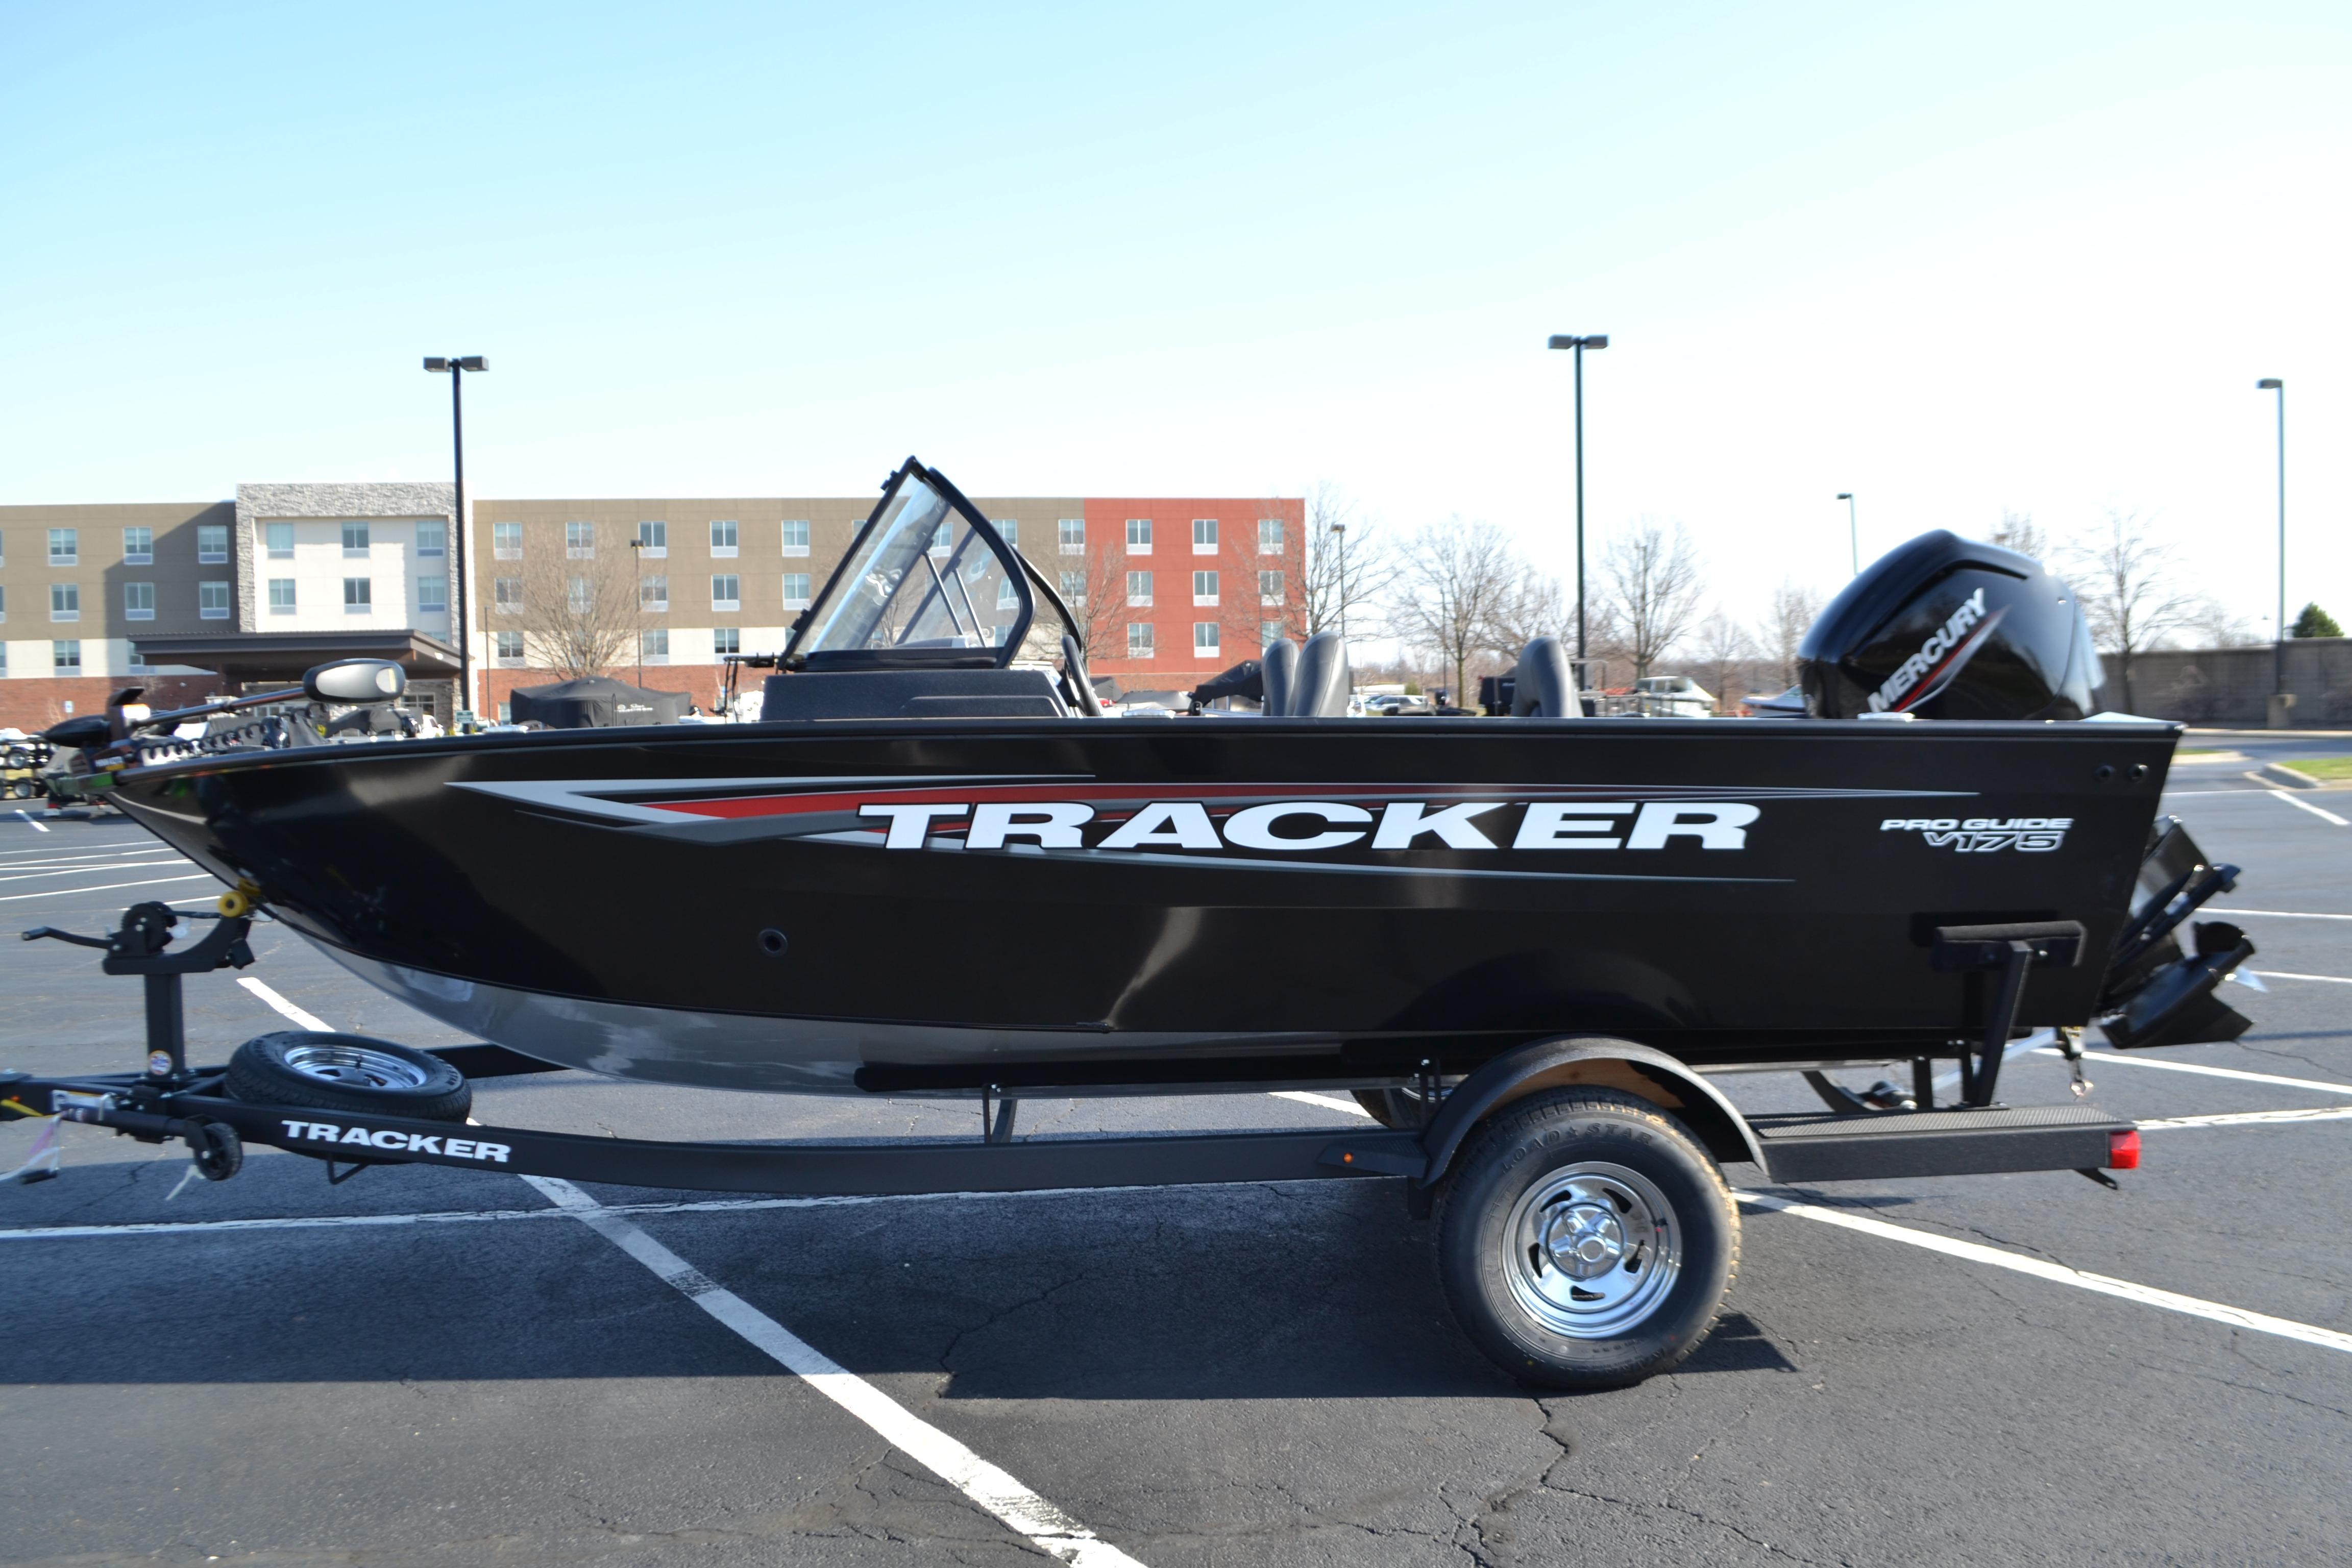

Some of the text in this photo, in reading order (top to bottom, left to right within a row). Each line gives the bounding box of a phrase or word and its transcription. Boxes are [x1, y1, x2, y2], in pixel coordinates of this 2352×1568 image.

[1867, 587, 1987, 713] MERCURY
[859, 802, 1759, 849] TRACKER
[1879, 818, 2075, 831] PRO GUIDE
[1922, 830, 2066, 852] V175
[281, 1120, 511, 1163] TRACKER
[1502, 1122, 1652, 1174] LOAD STAR
